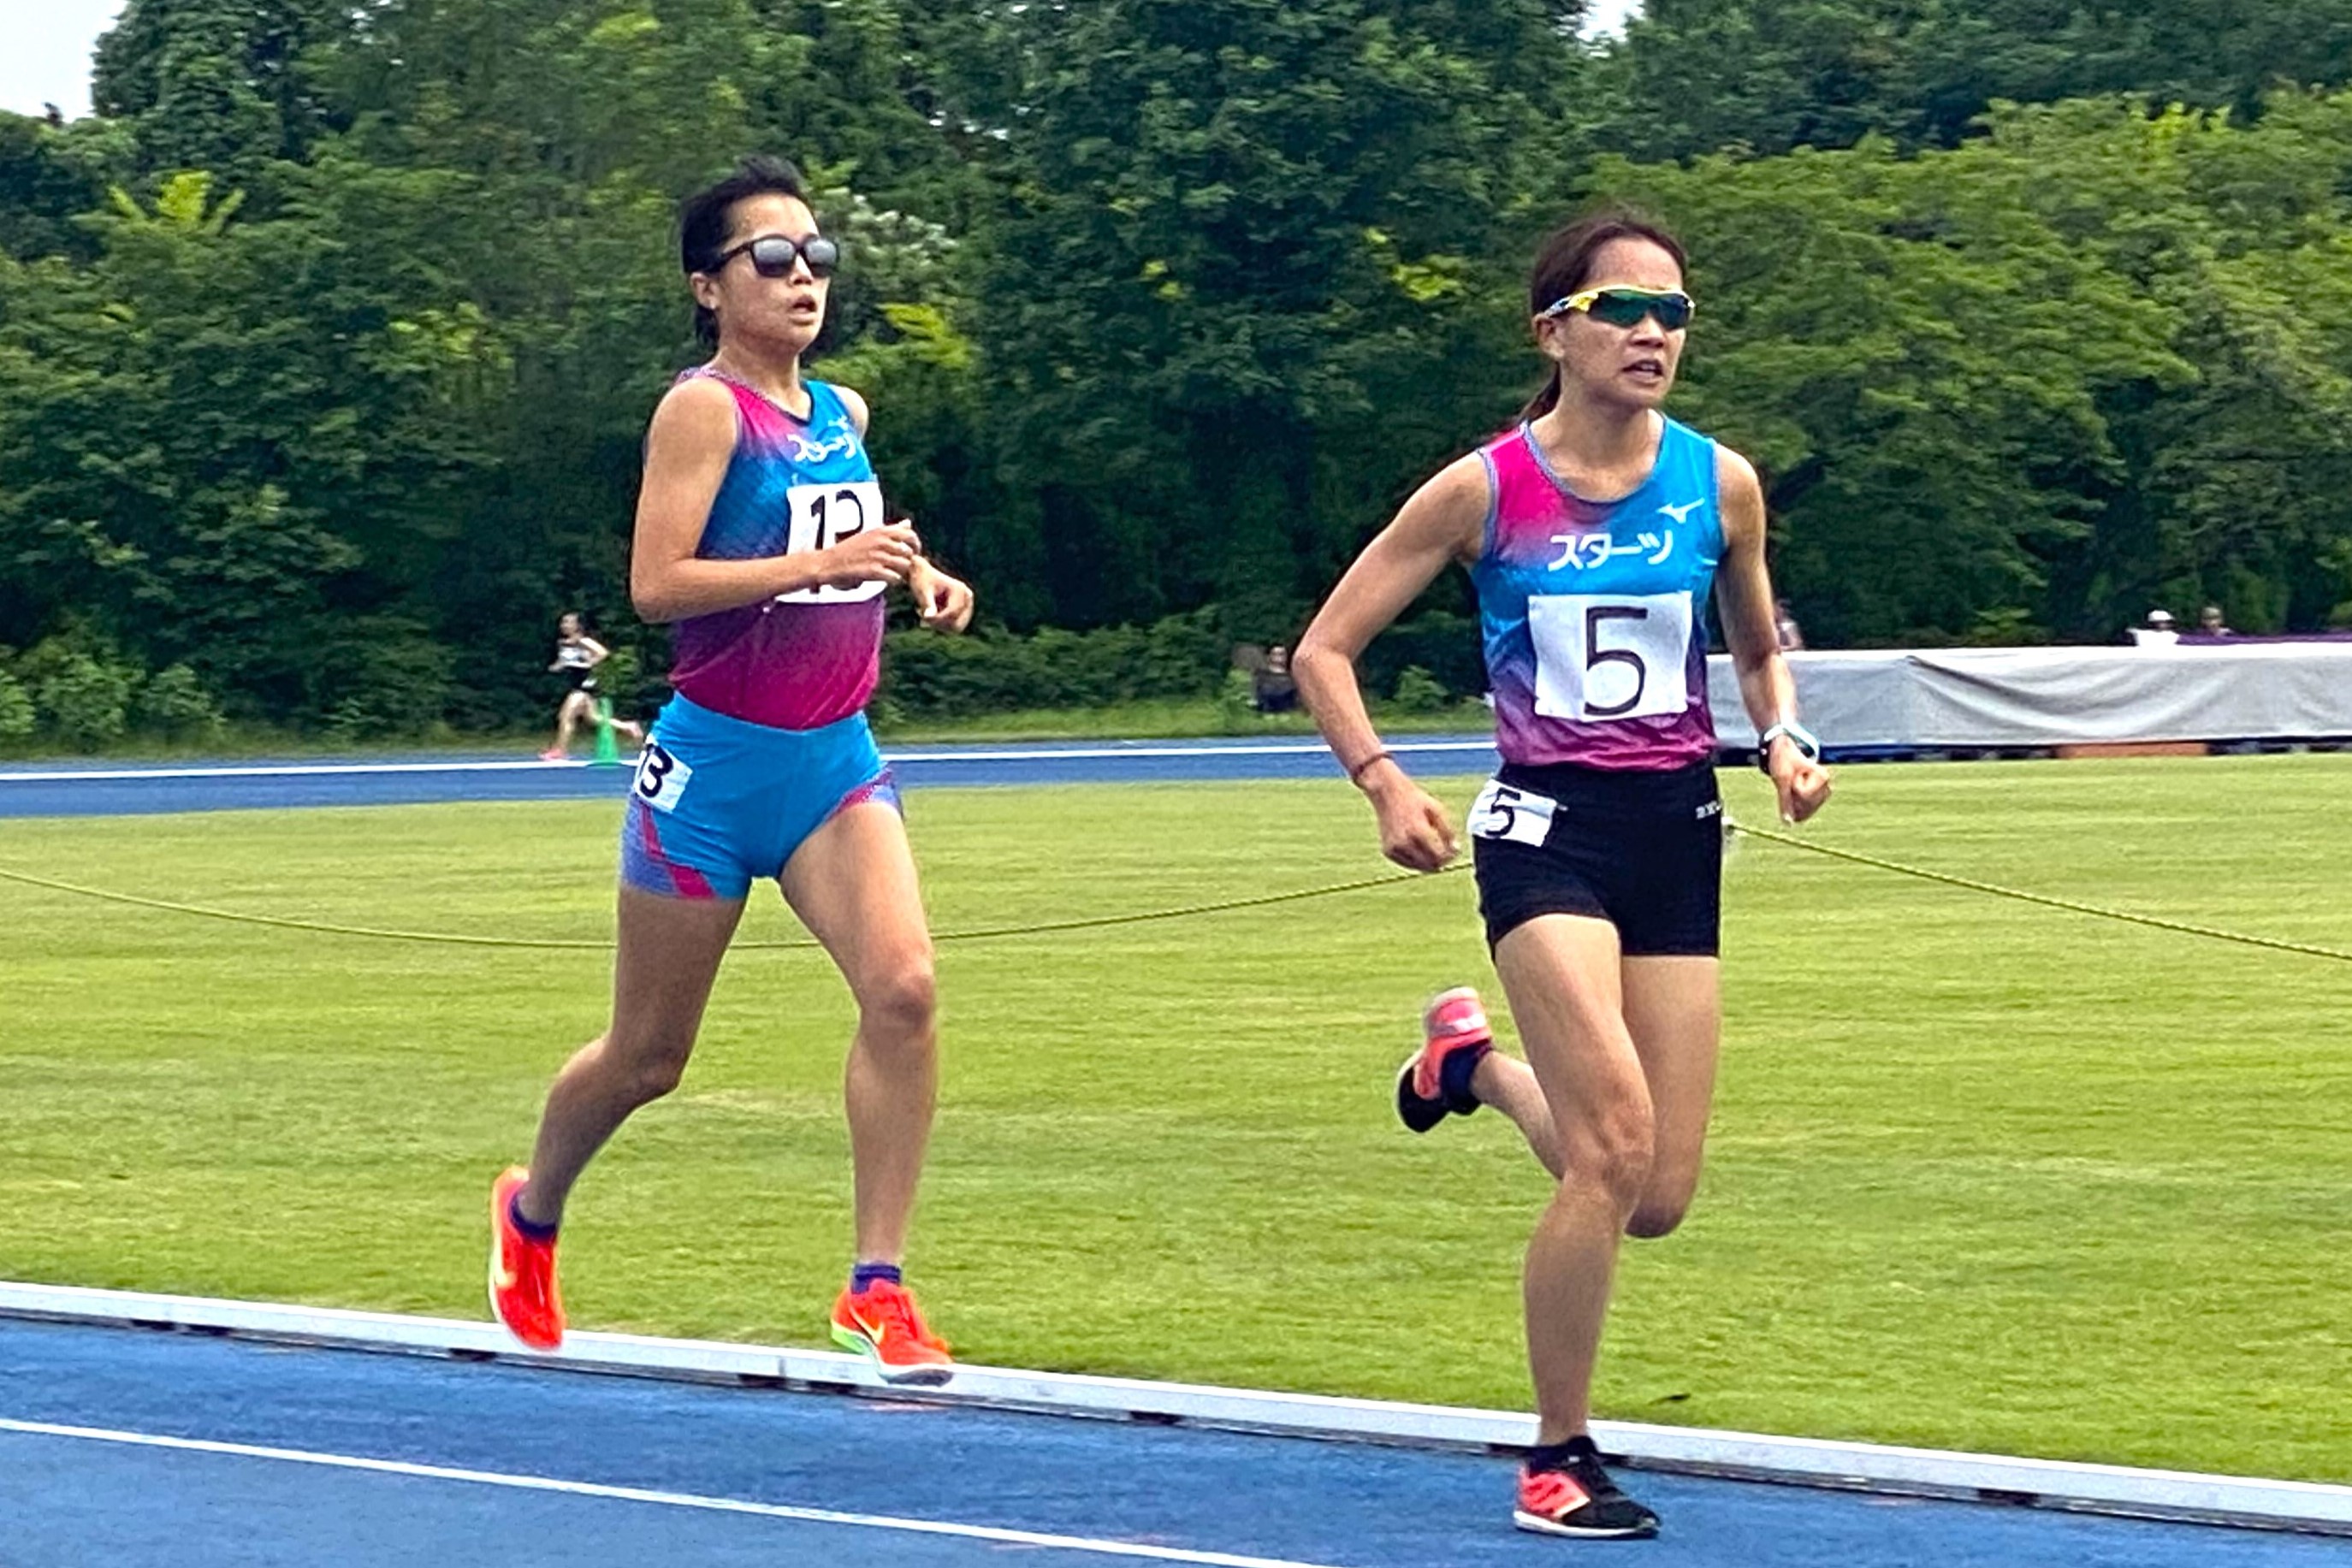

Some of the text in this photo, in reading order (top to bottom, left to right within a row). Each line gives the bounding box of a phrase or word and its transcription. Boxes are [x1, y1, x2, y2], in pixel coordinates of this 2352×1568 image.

[1548, 530, 1674, 572] スターツ
[1584, 606, 1648, 716] 5
[1484, 786, 1522, 837] 5
